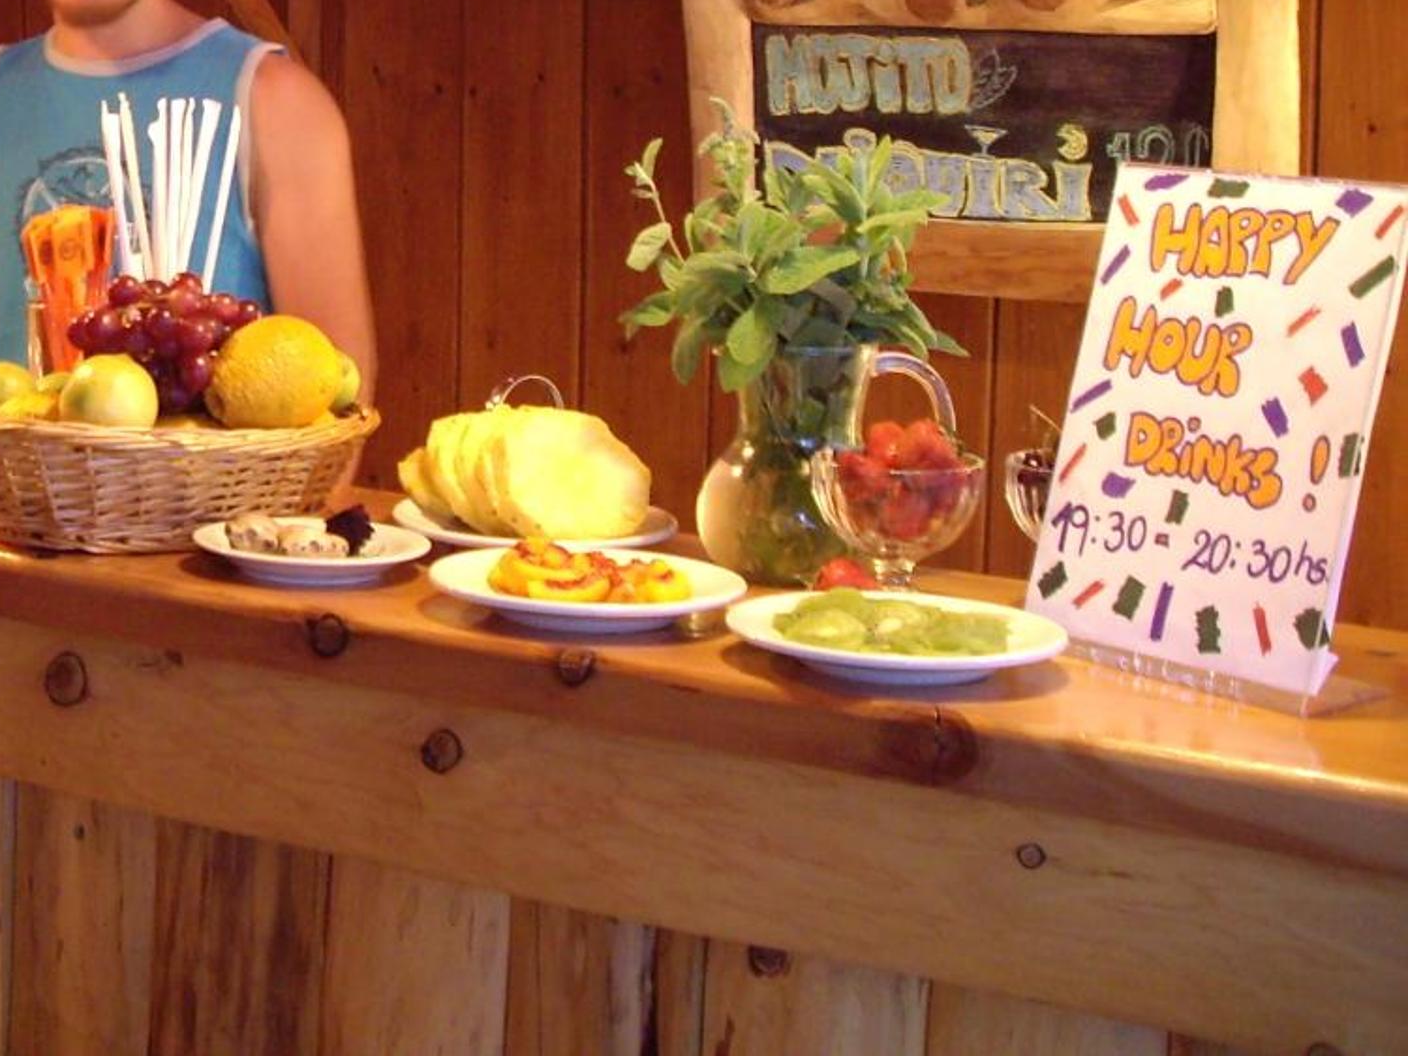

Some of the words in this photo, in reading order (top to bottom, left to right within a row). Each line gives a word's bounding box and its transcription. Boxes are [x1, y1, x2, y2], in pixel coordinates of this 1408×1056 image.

[1149, 202, 1341, 285] HAPPY
[1102, 296, 1253, 397] HOUR
[1051, 502, 1147, 558] 19:30
